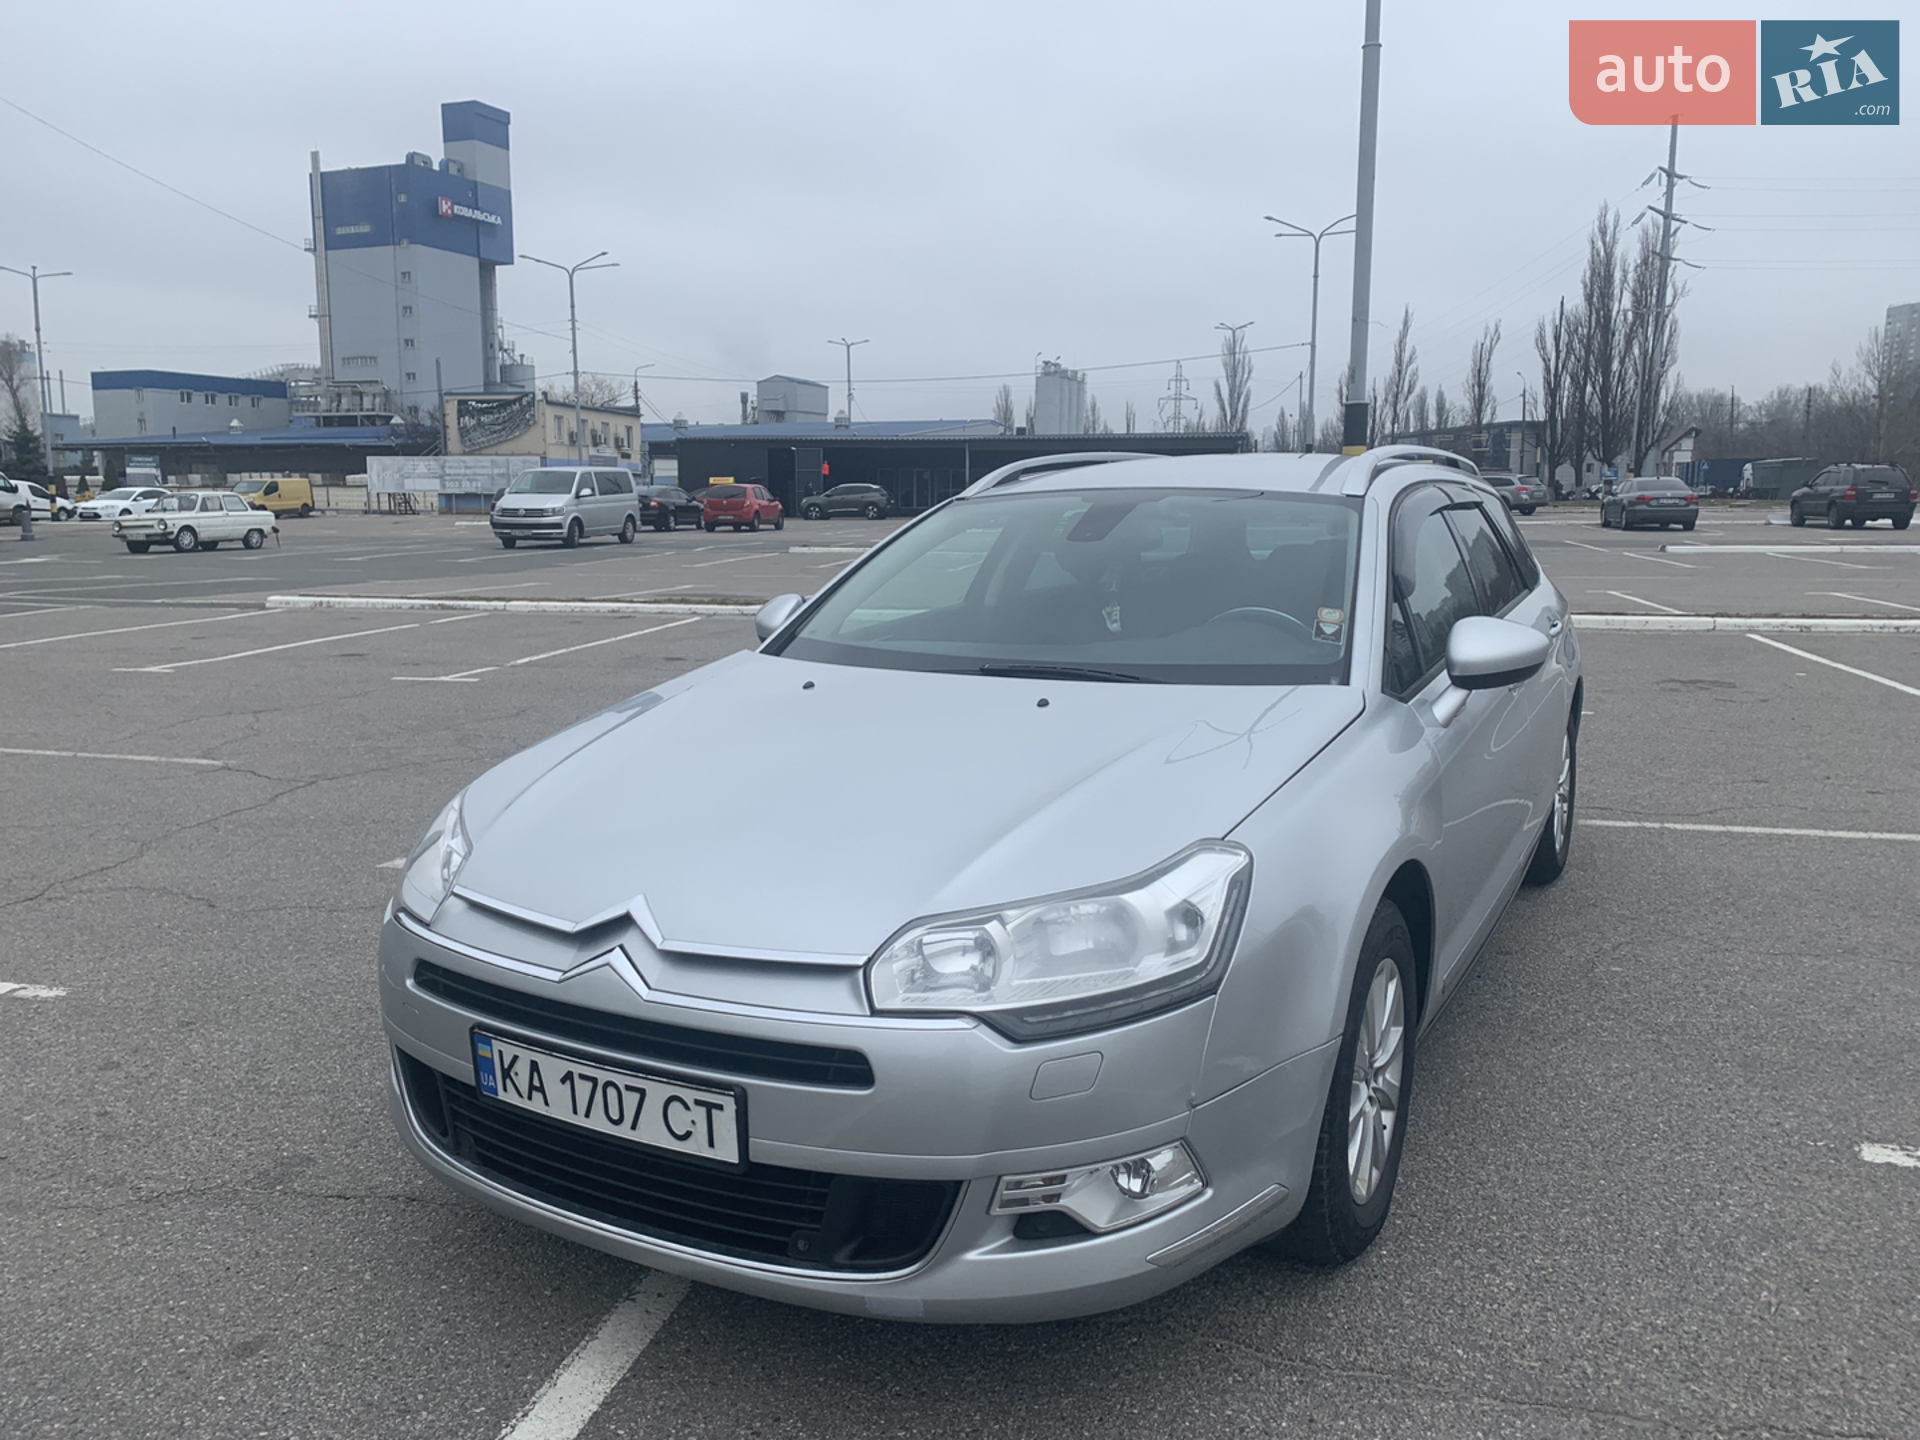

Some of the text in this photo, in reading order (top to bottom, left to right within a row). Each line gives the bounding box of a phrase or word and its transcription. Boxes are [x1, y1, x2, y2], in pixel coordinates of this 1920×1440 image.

[453, 204, 503, 225] КОВАЛЬСЬКА
[479, 1071, 497, 1088] UA
[498, 1049, 725, 1149] KA 1707 CT
